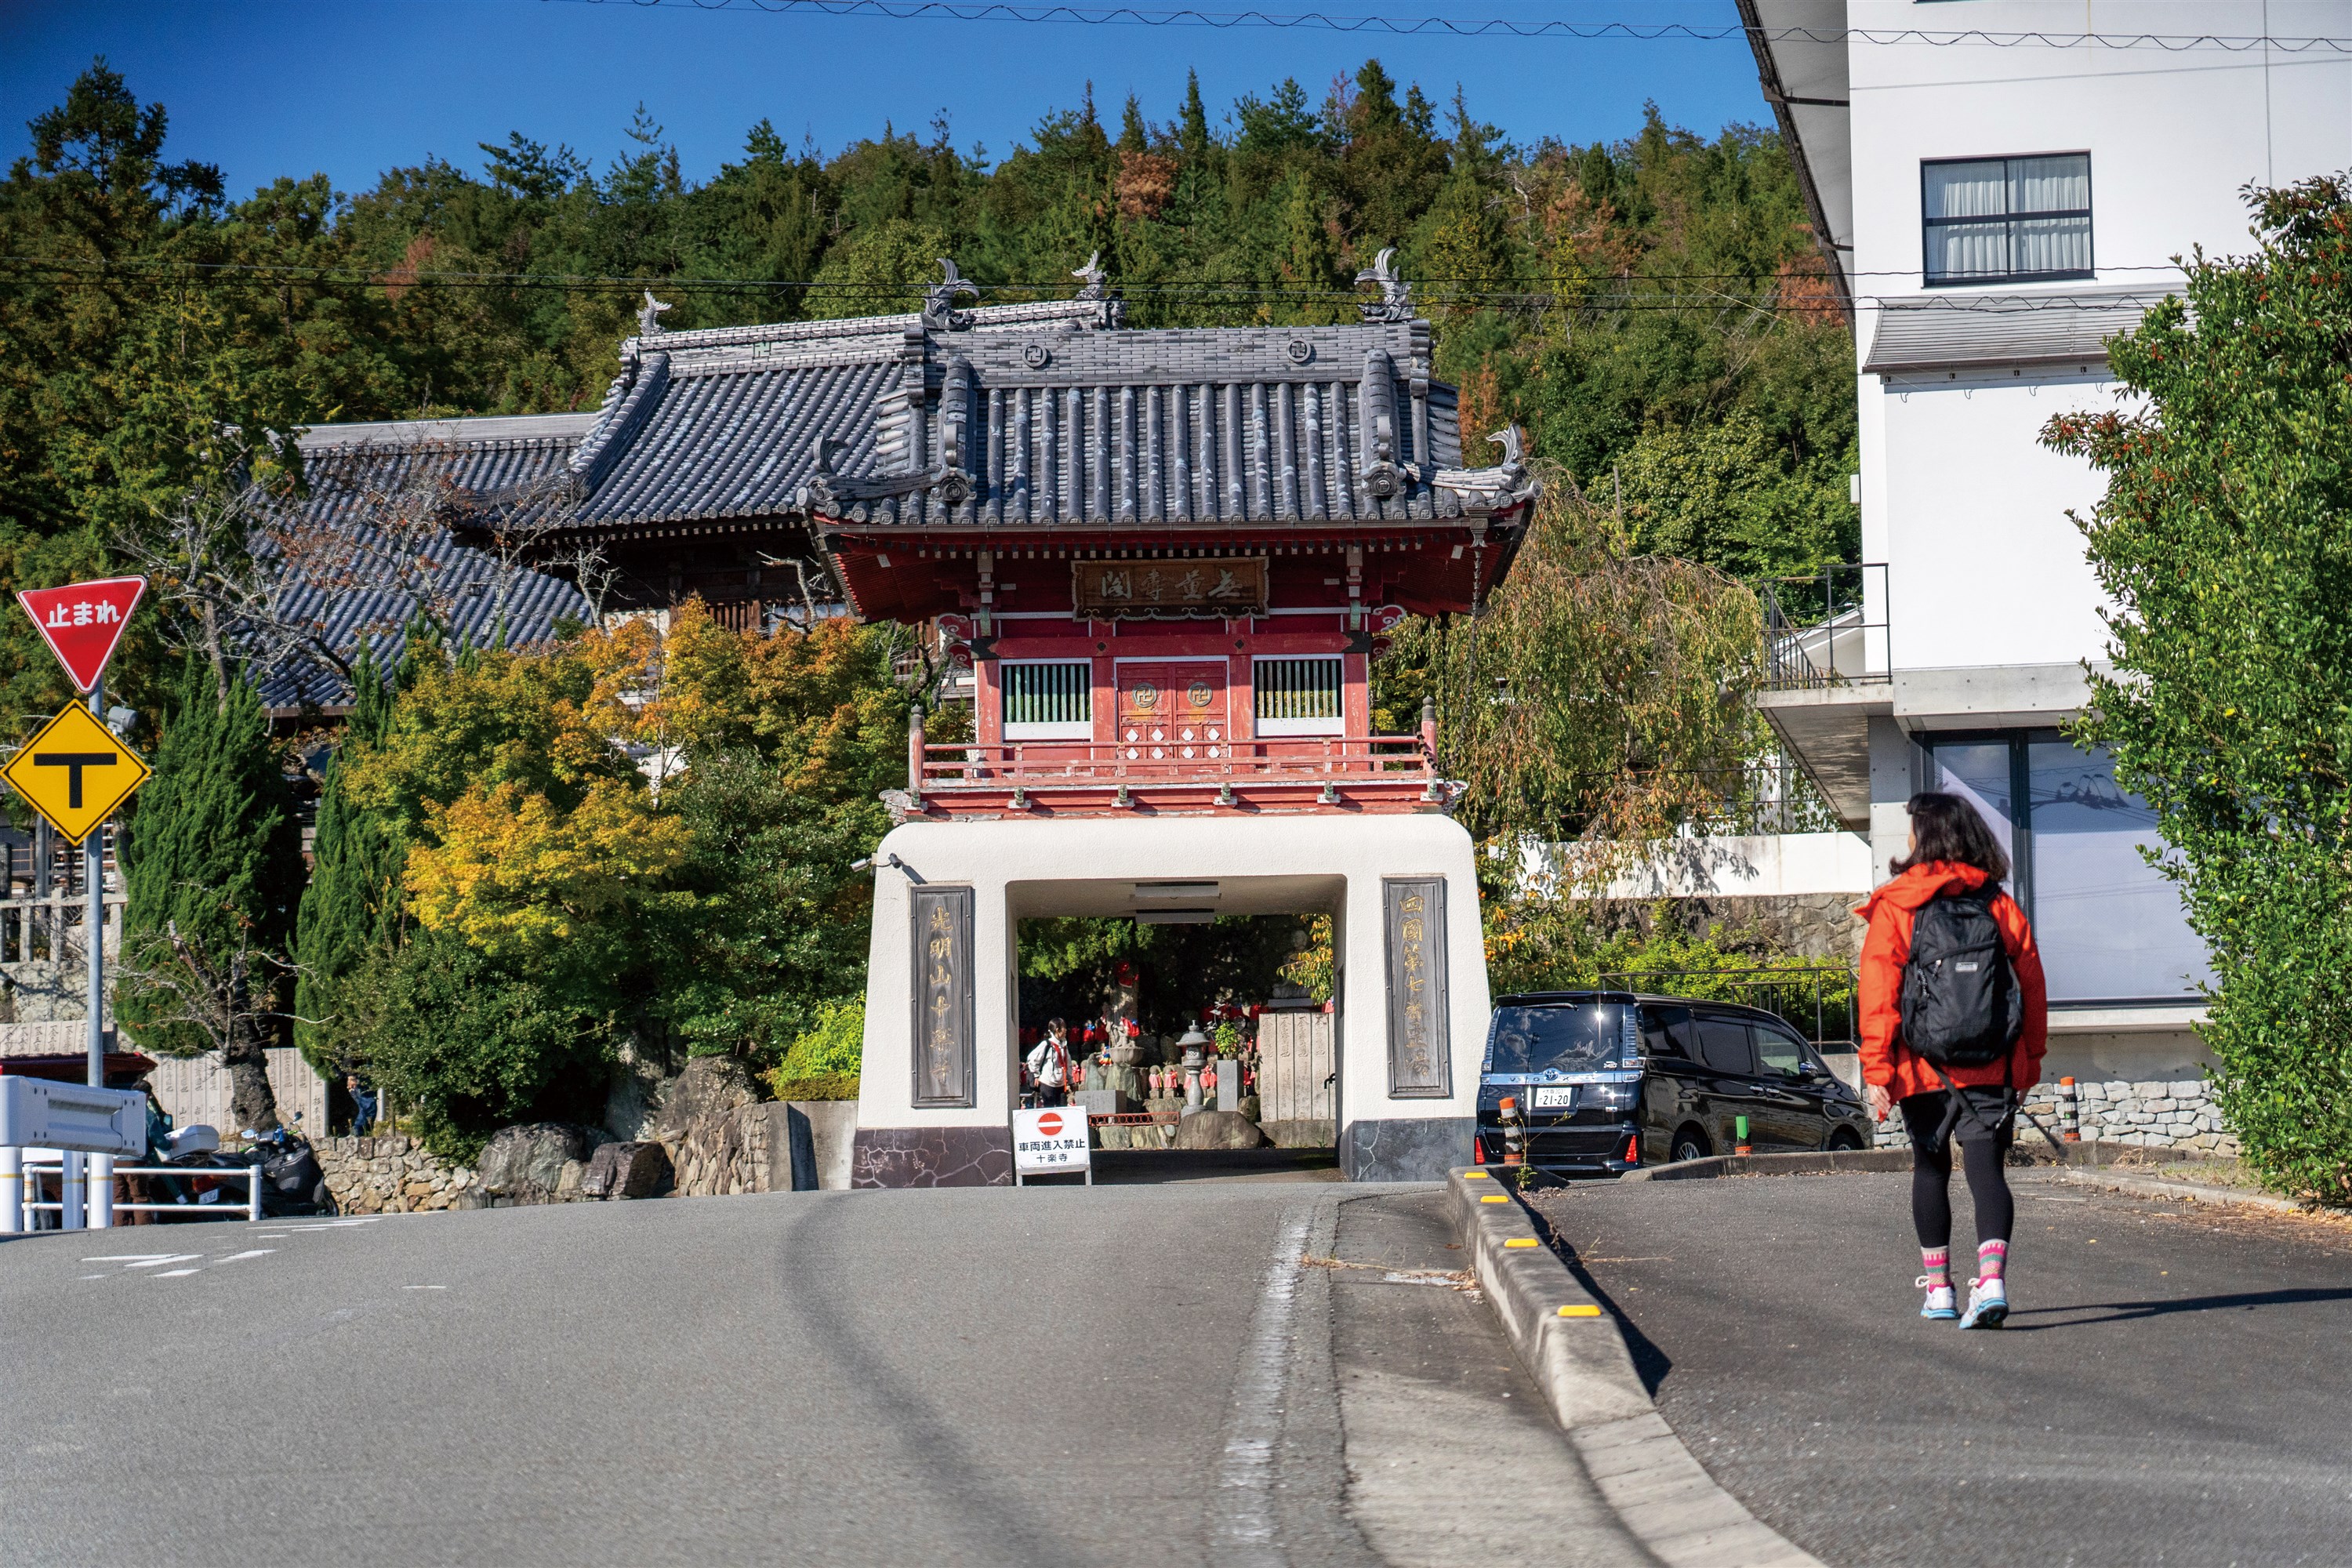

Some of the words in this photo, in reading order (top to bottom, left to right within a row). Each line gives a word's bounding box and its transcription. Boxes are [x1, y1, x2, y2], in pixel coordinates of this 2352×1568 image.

[45, 600, 121, 628] 止まれ
[1543, 1094, 1569, 1105] 21-20
[1018, 1138, 1086, 1152] 車両進入禁止
[1036, 1152, 1069, 1163] 十楽寺
